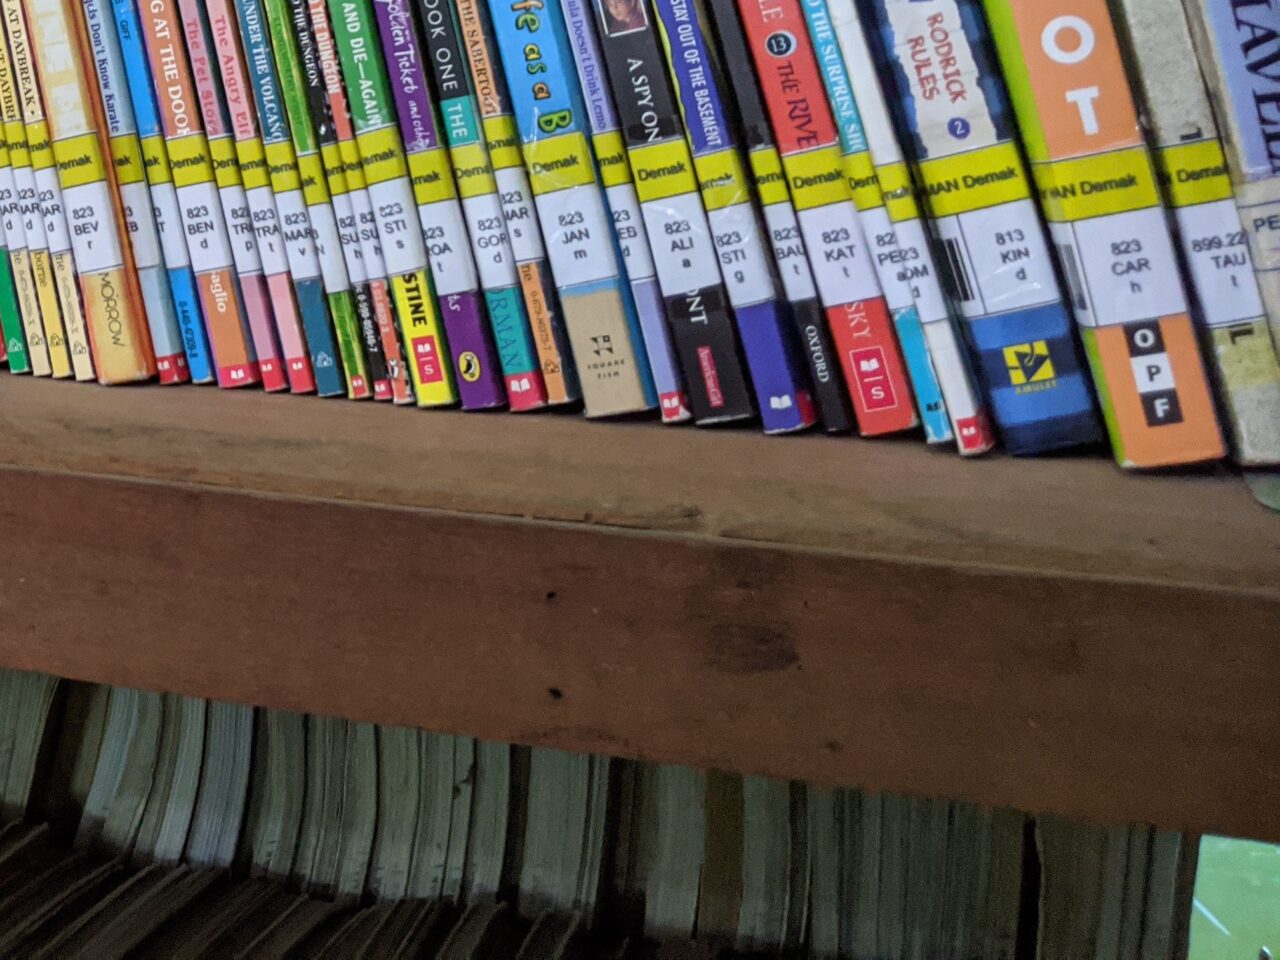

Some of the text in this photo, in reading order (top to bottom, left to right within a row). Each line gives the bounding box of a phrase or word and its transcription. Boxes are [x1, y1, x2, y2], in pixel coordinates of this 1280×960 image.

[342, 2, 361, 33] AND
[678, 24, 696, 47] OUT
[523, 43, 548, 77] as
[627, 58, 643, 72] A
[684, 48, 701, 65] OF
[811, 11, 832, 41] THE
[822, 45, 853, 119] SURPRISE
[926, 11, 968, 105] RODRICK
[436, 47, 458, 90] ONE
[689, 66, 706, 87] THE
[907, 35, 940, 102] RULES
[532, 82, 552, 100] a
[632, 75, 654, 107] SPY
[448, 103, 468, 137] THE
[538, 110, 572, 134] B
[694, 89, 722, 146] BASEMENT
[954, 120, 965, 136] 2
[637, 162, 687, 182] Demak
[792, 168, 844, 189] Demak
[961, 166, 1018, 189] Demak
[1082, 174, 1138, 196] Demak
[72, 206, 94, 219] 823
[186, 206, 210, 218] 823
[74, 221, 99, 235] BEV
[188, 220, 215, 233] BEN
[384, 219, 408, 234] STI
[663, 220, 692, 234] 823
[822, 227, 850, 242] 823
[670, 237, 694, 252] ALI
[995, 229, 1025, 245] 813
[824, 244, 856, 261] KAT
[1000, 248, 1030, 263] KIN
[1110, 240, 1142, 255] 823
[1111, 257, 1151, 275] CAR
[97, 271, 125, 348] MORROW
[402, 272, 428, 328] STINE
[804, 324, 830, 383] OXFORD
